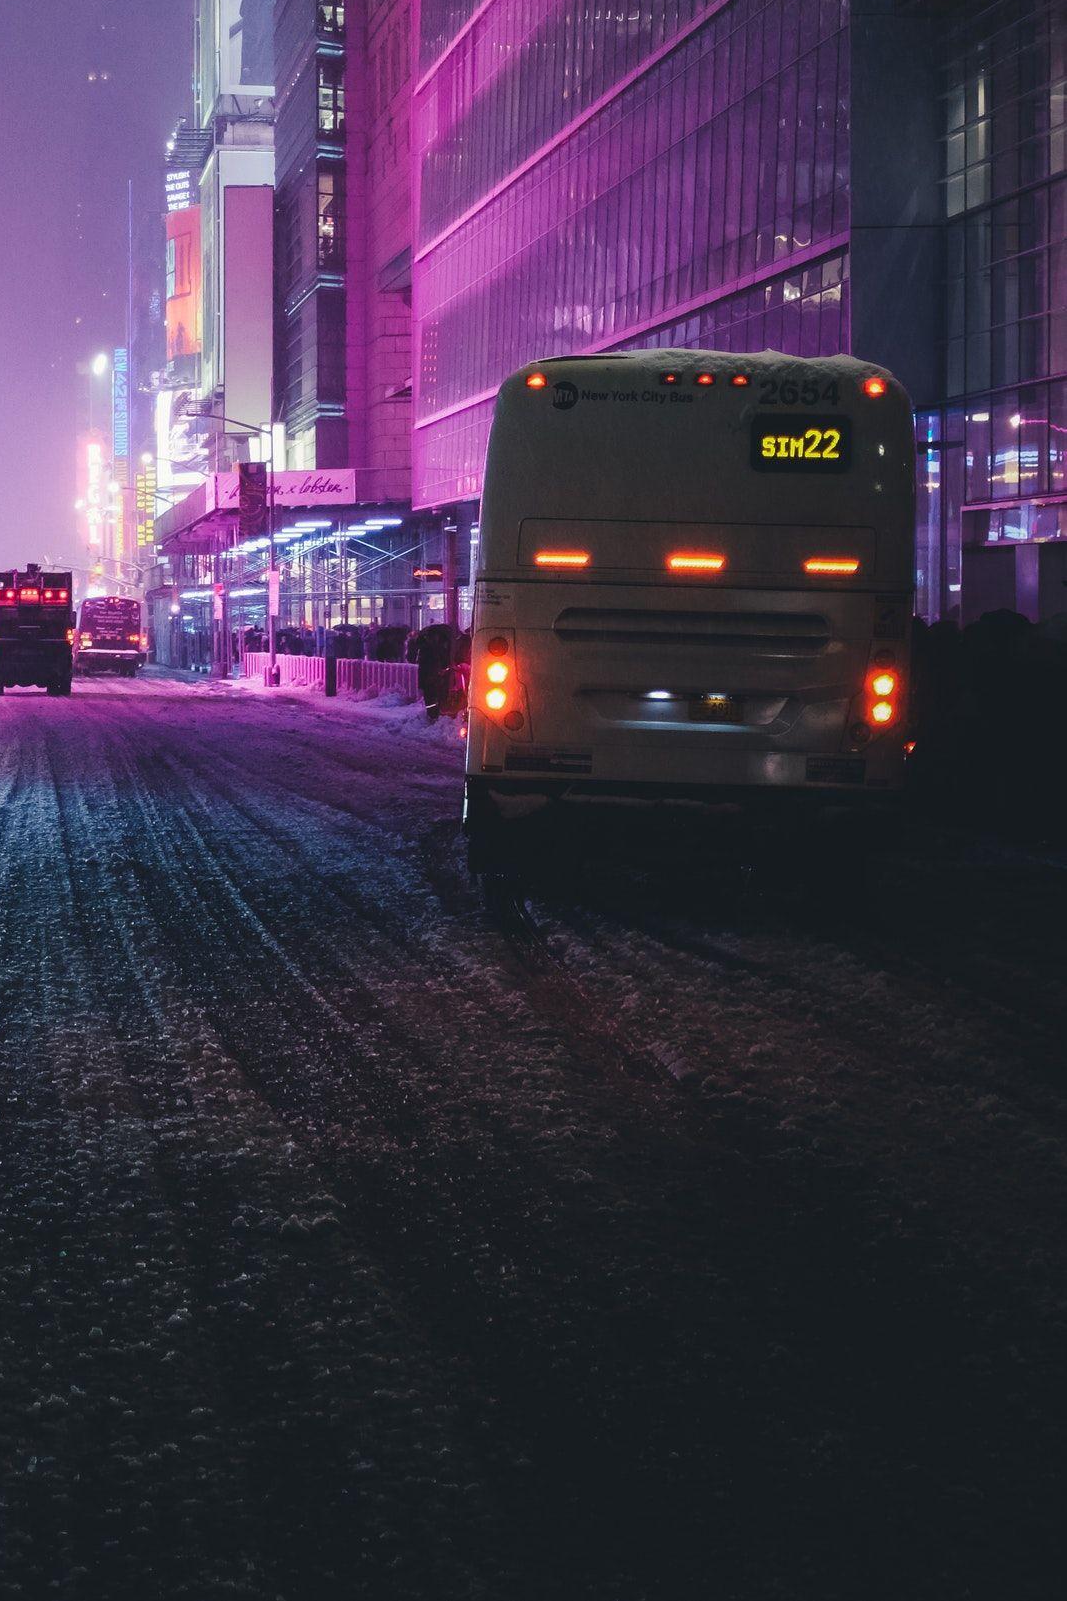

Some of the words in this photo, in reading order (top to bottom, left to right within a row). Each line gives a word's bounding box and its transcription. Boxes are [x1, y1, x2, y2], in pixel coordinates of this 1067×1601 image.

[114, 348, 128, 371] NEW
[582, 389, 608, 401] New
[611, 389, 638, 402] York
[642, 390, 666, 404] City
[670, 391, 693, 403] Bus
[758, 380, 840, 406] 2654
[114, 412, 128, 456] STUDIOS
[761, 428, 841, 459] SIM22
